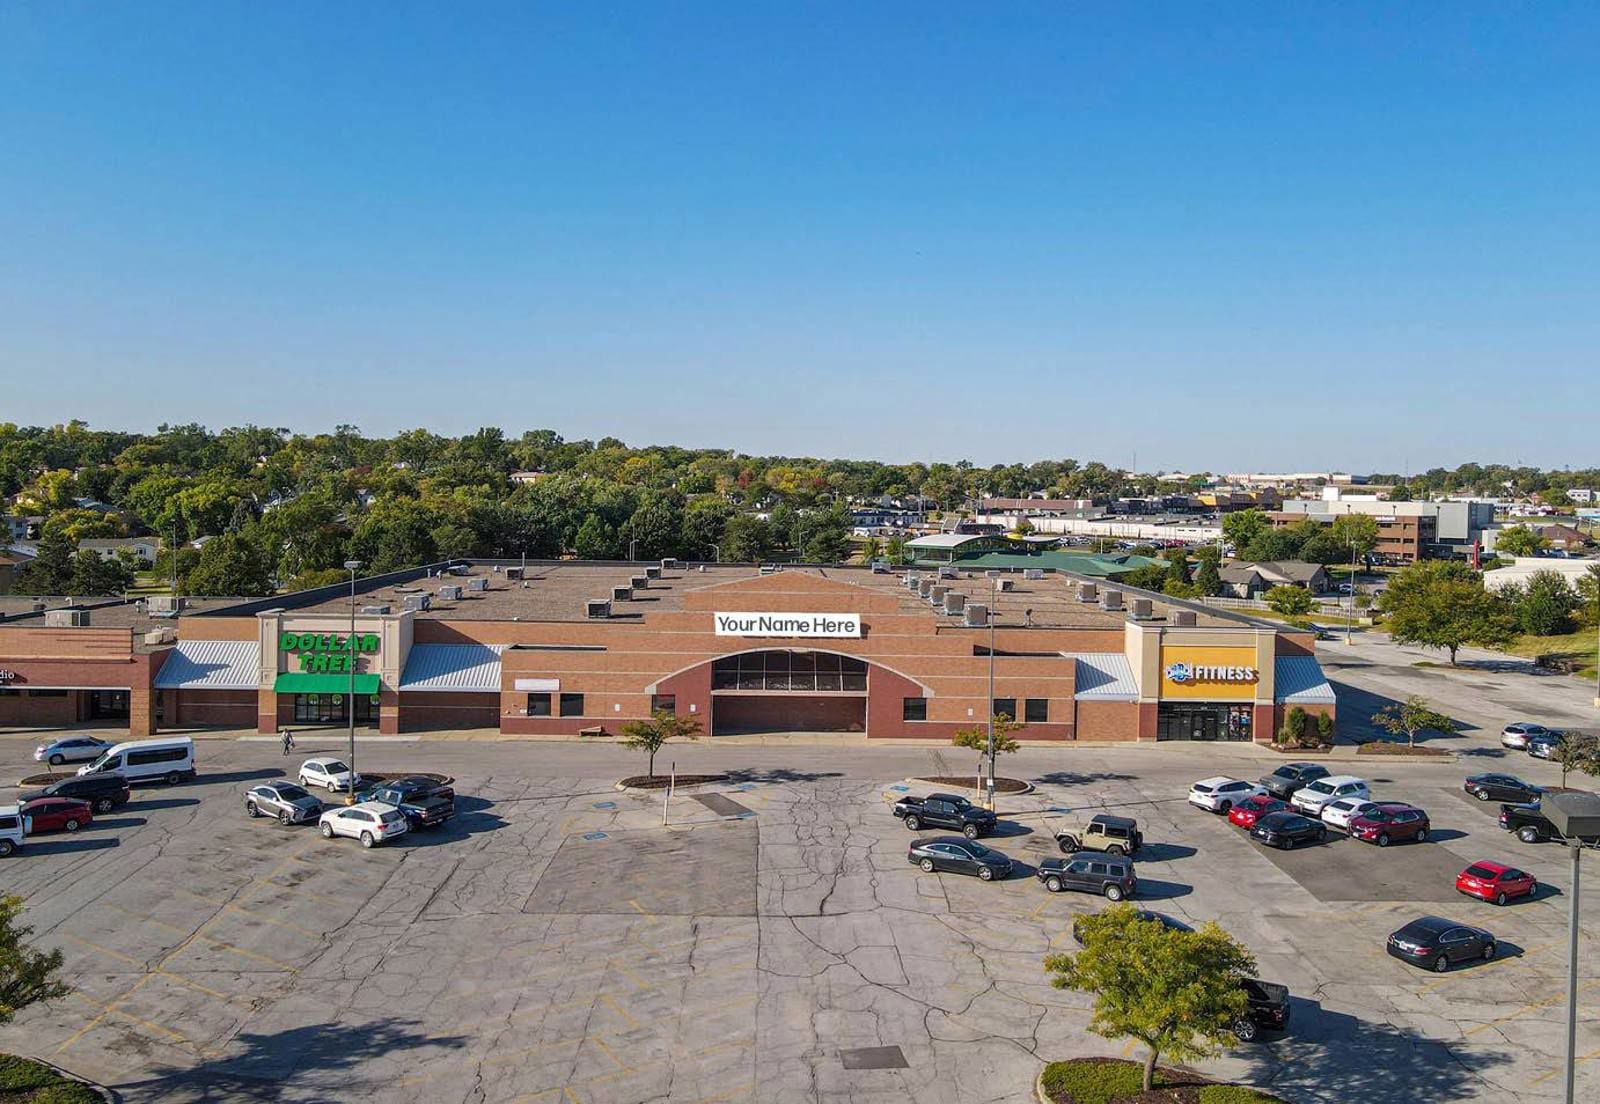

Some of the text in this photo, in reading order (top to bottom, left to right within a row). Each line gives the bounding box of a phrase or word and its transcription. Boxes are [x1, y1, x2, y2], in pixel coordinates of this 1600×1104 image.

[718, 616, 856, 633] Your Name Here
[279, 631, 379, 651] DOLLAR
[297, 653, 359, 672] TREE
[1195, 665, 1254, 680] FITNESS
